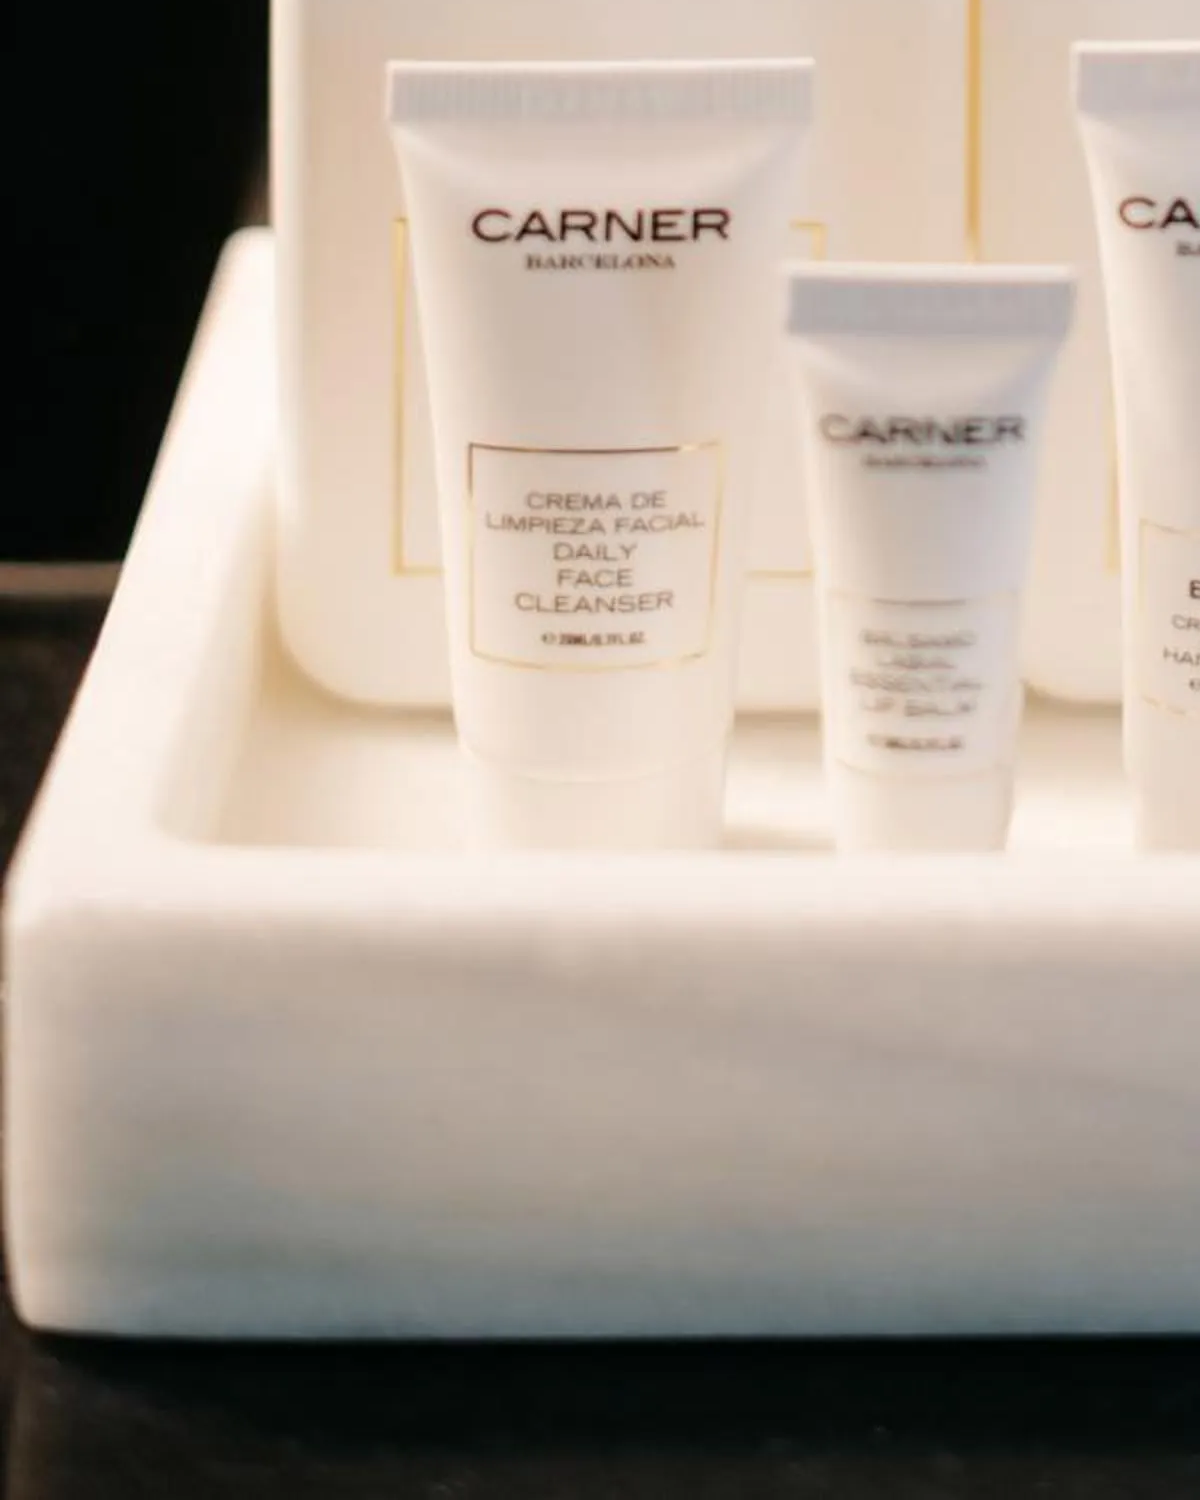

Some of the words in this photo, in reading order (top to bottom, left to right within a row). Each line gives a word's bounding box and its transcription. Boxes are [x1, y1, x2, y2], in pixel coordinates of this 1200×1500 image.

[471, 208, 731, 243] CARNER
[525, 253, 677, 271] BARCELONA
[819, 414, 1026, 445] CARNER
[526, 491, 622, 511] CREMA
[630, 490, 668, 510] DE
[484, 509, 606, 536] LIMPIEZA
[613, 510, 706, 534] FACIAL
[552, 541, 637, 562] DAILY
[556, 567, 634, 589] FACE
[514, 590, 674, 614] CLEANSER
